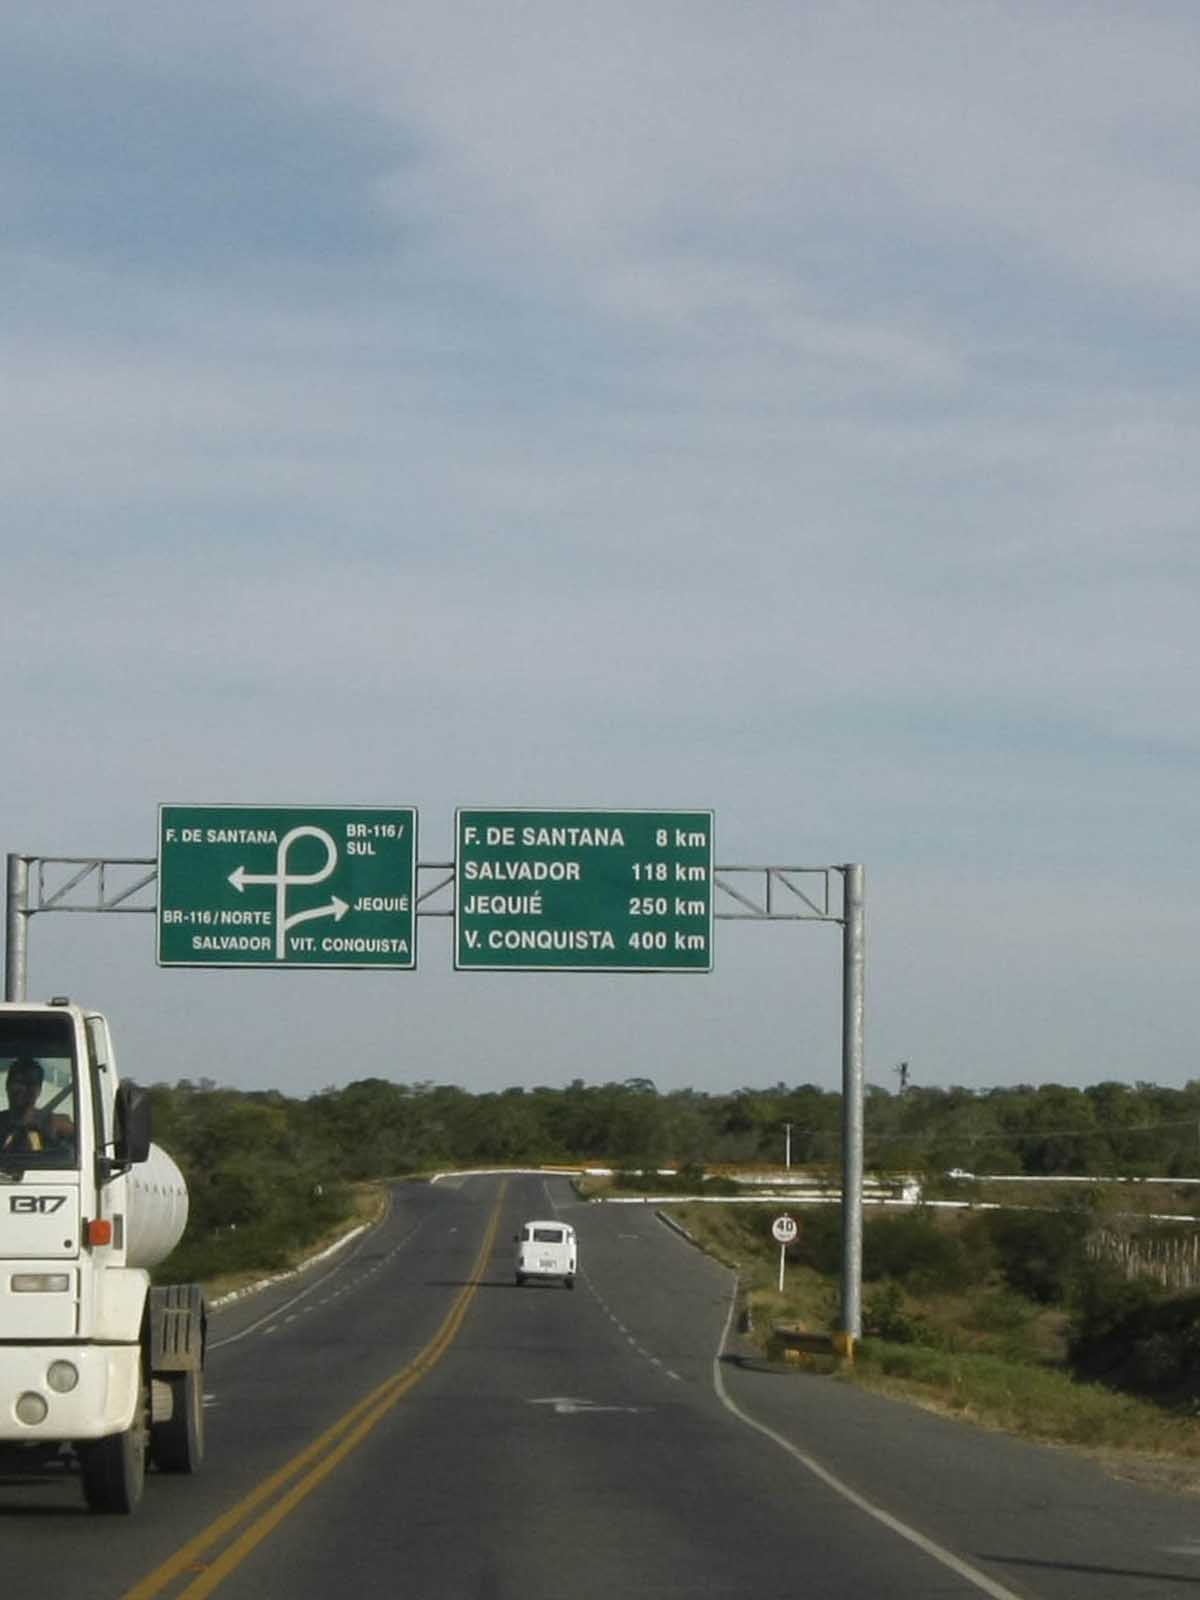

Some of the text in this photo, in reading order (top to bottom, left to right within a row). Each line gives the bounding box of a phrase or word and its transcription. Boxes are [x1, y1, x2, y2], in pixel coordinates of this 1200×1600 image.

[165, 828, 278, 844] F. DE SANTANA
[464, 826, 625, 847] F. DE SANTANA
[655, 828, 706, 848] 8 km
[346, 840, 377, 856] SUL
[464, 860, 580, 881] SALVADOR
[631, 862, 706, 881] 118 km
[463, 889, 543, 915] JEQUIÉ
[628, 896, 705, 916] 250 km
[192, 935, 271, 951] SALVADOR
[289, 937, 409, 954] VIT. CONQUISTA
[464, 929, 616, 950] V. CONQUISTA
[628, 931, 705, 950] 400 km
[776, 1219, 794, 1233] 40
